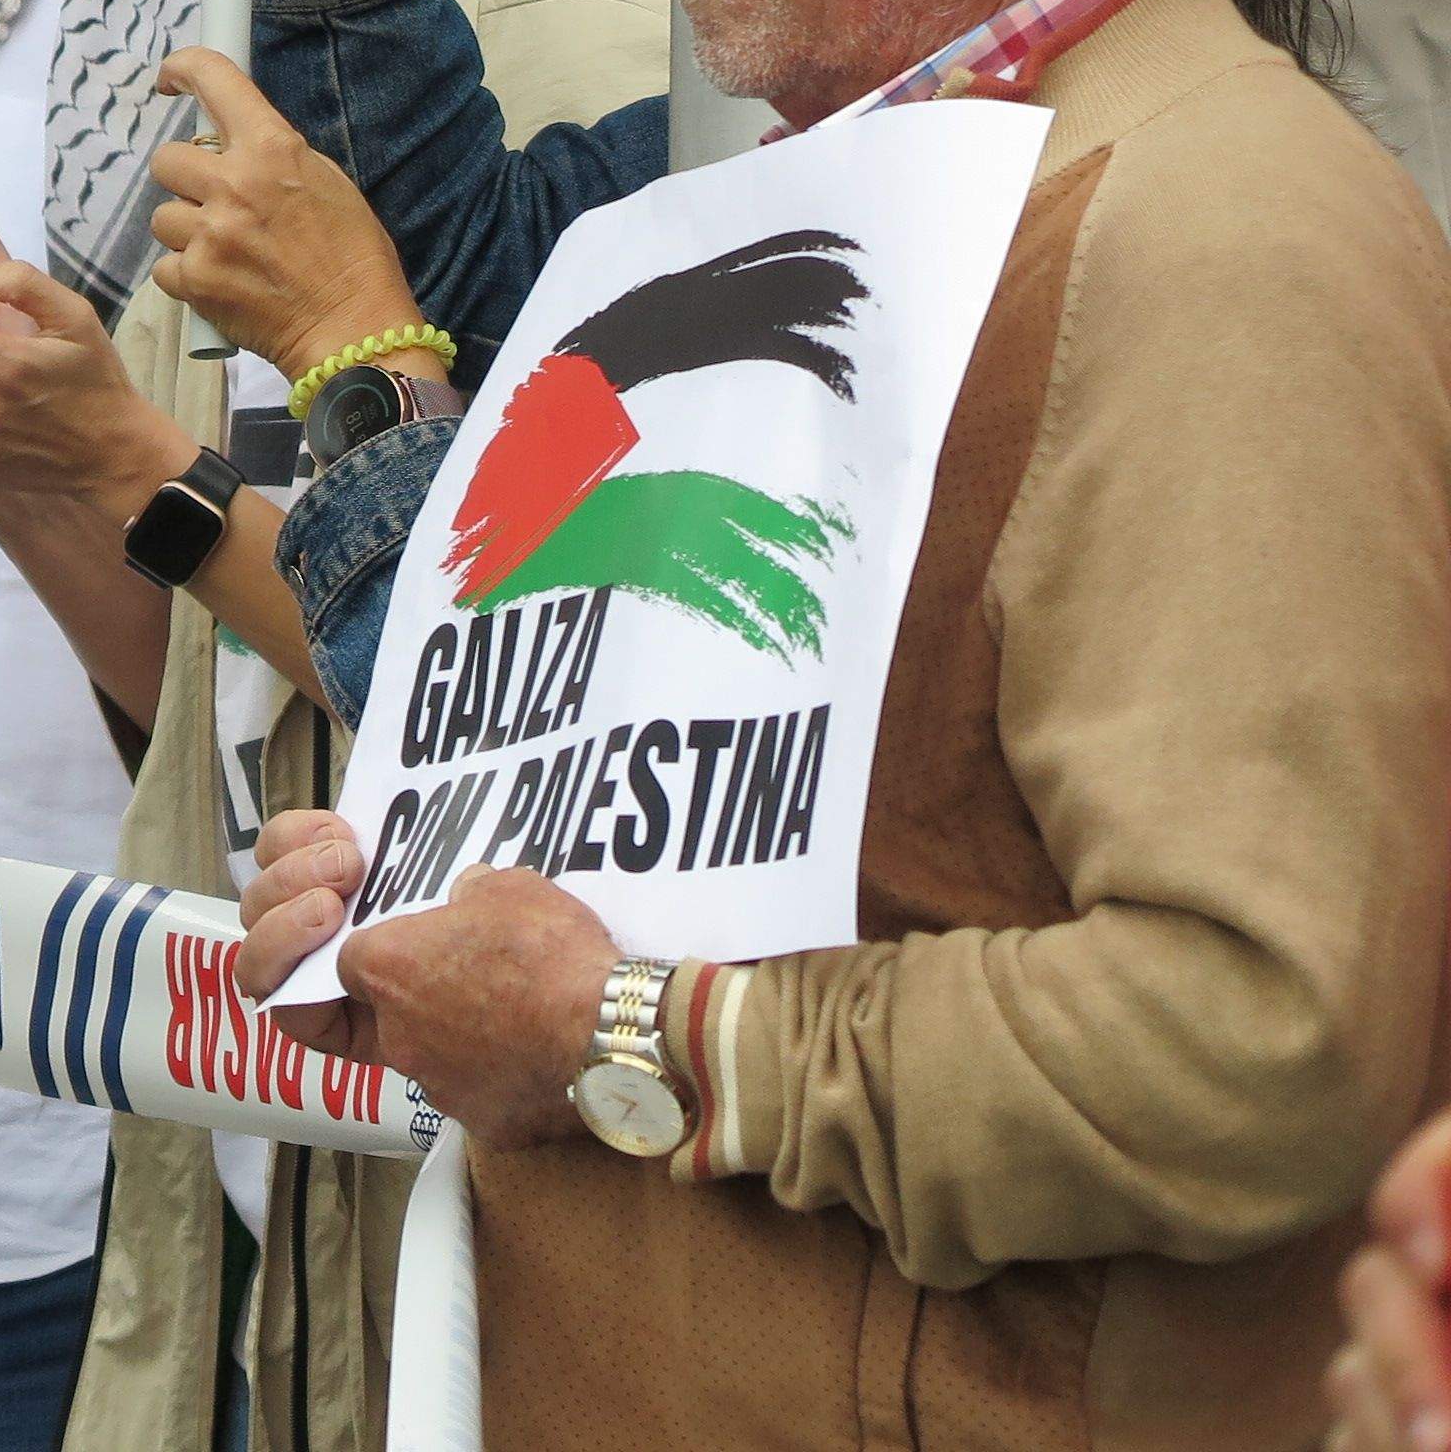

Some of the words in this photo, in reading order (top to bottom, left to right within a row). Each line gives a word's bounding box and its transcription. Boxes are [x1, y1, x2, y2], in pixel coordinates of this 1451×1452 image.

[401, 585, 612, 769] GALIZA
[352, 769, 498, 927] CON
[479, 703, 831, 879] PALESTINA
